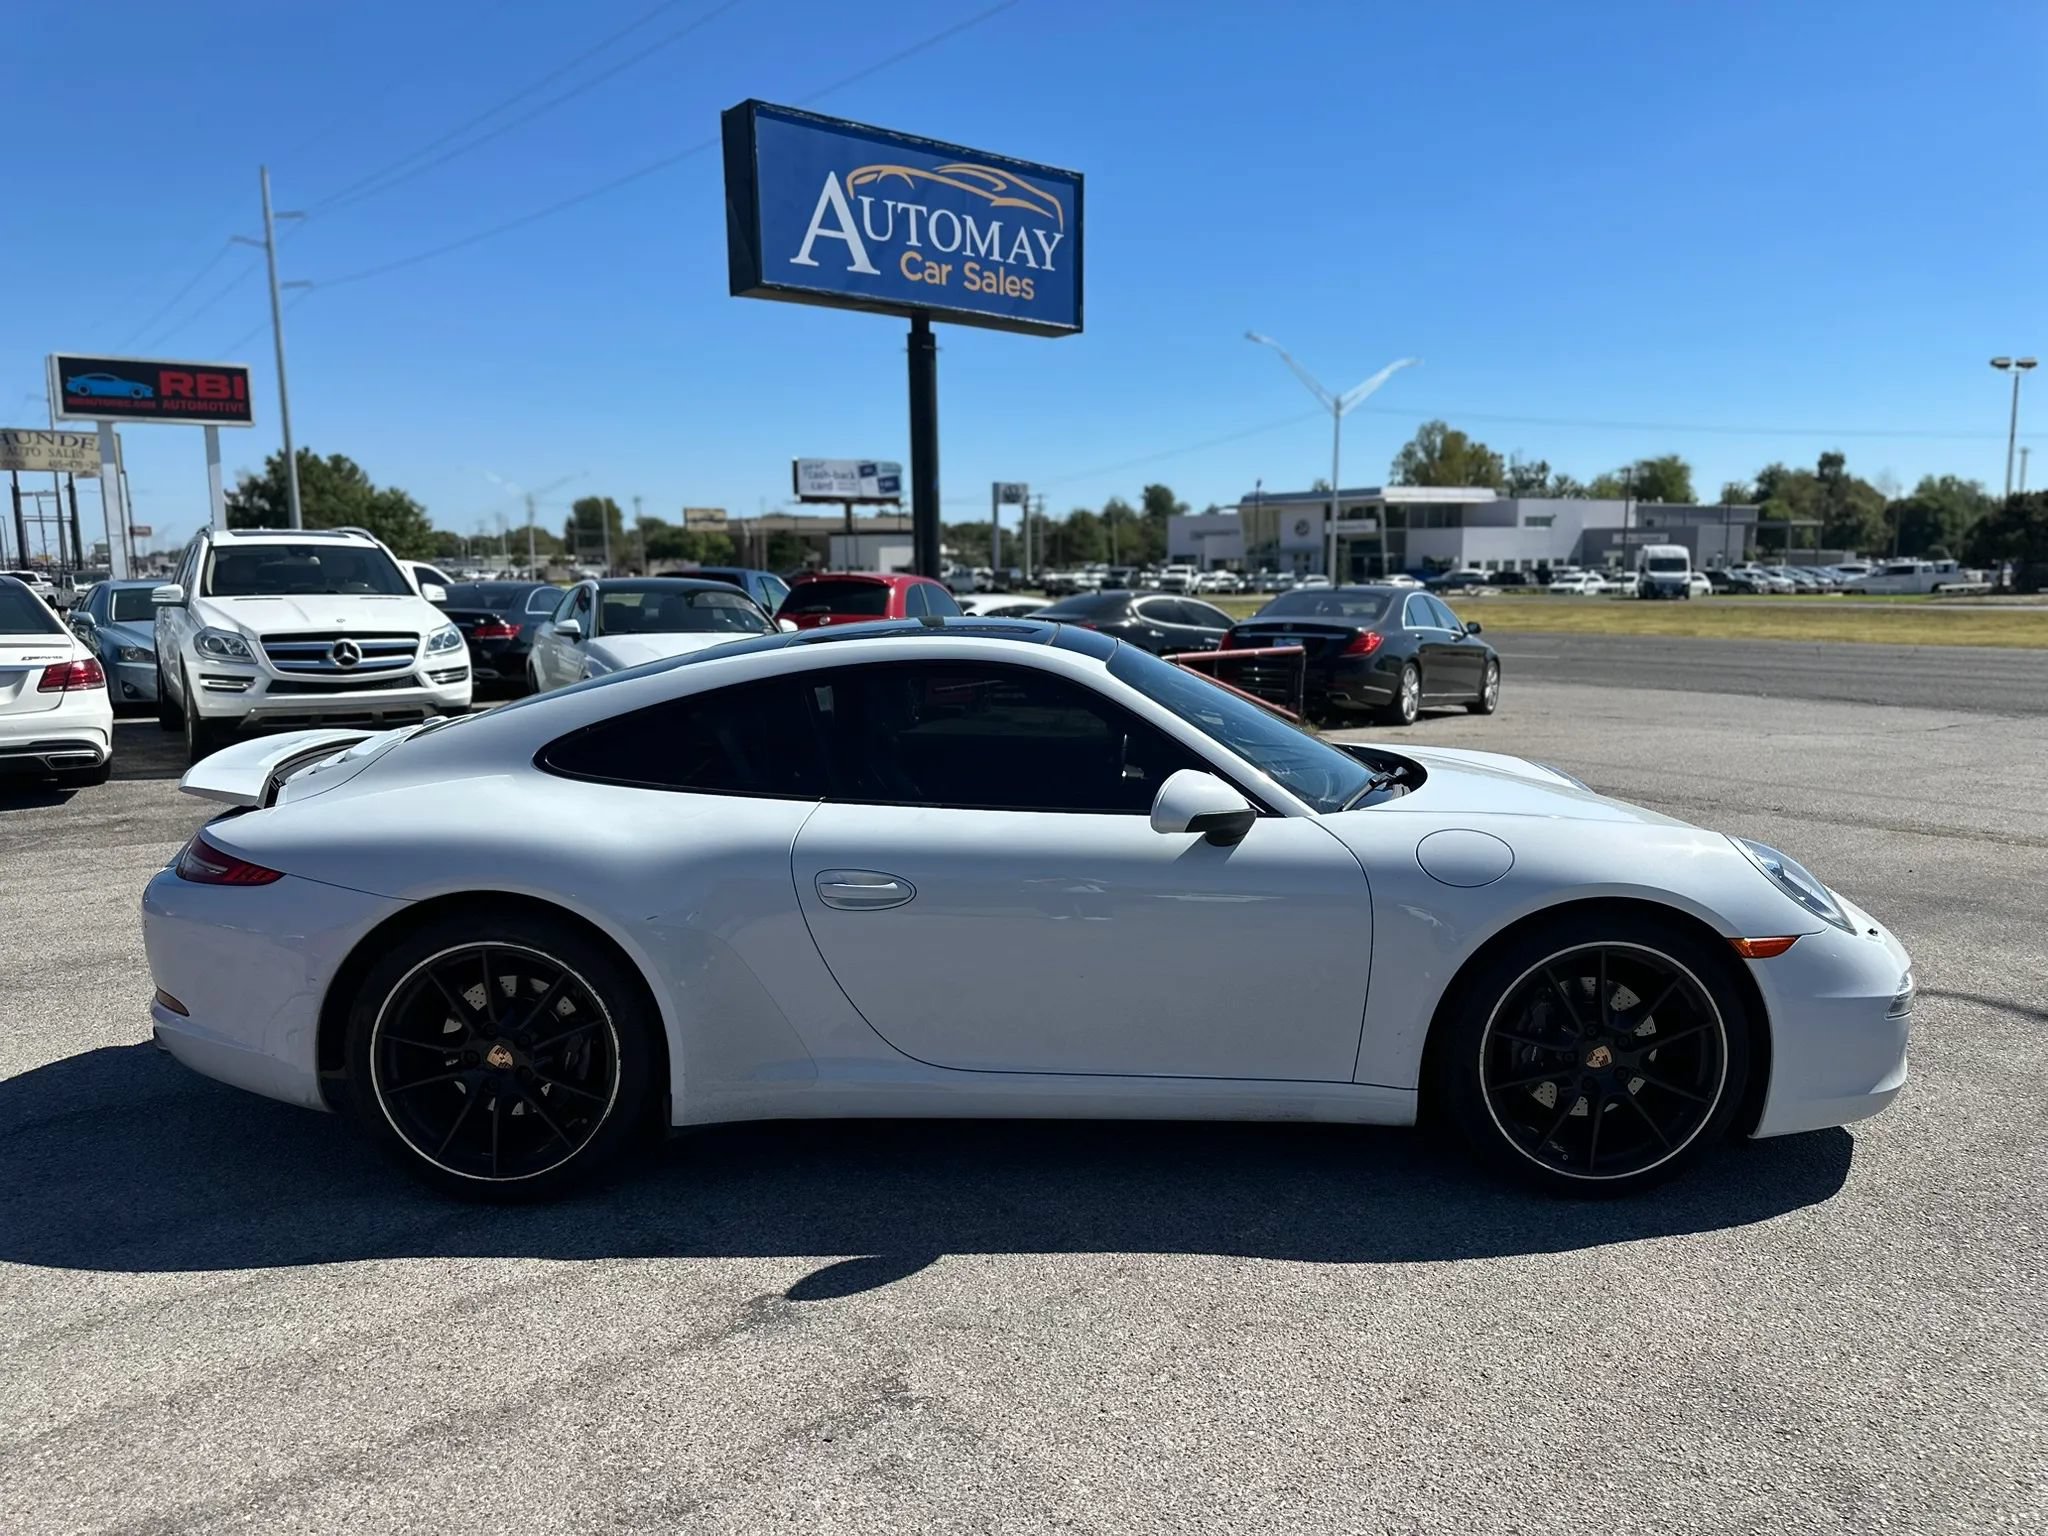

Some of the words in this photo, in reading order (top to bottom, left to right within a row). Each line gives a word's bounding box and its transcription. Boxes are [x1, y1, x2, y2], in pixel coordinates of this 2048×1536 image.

[899, 250, 952, 287] Car
[963, 263, 1036, 301] Sales
[159, 371, 246, 400] RBI
[162, 400, 245, 413] AUTOMOTIVE
[47, 448, 86, 460] SALES
